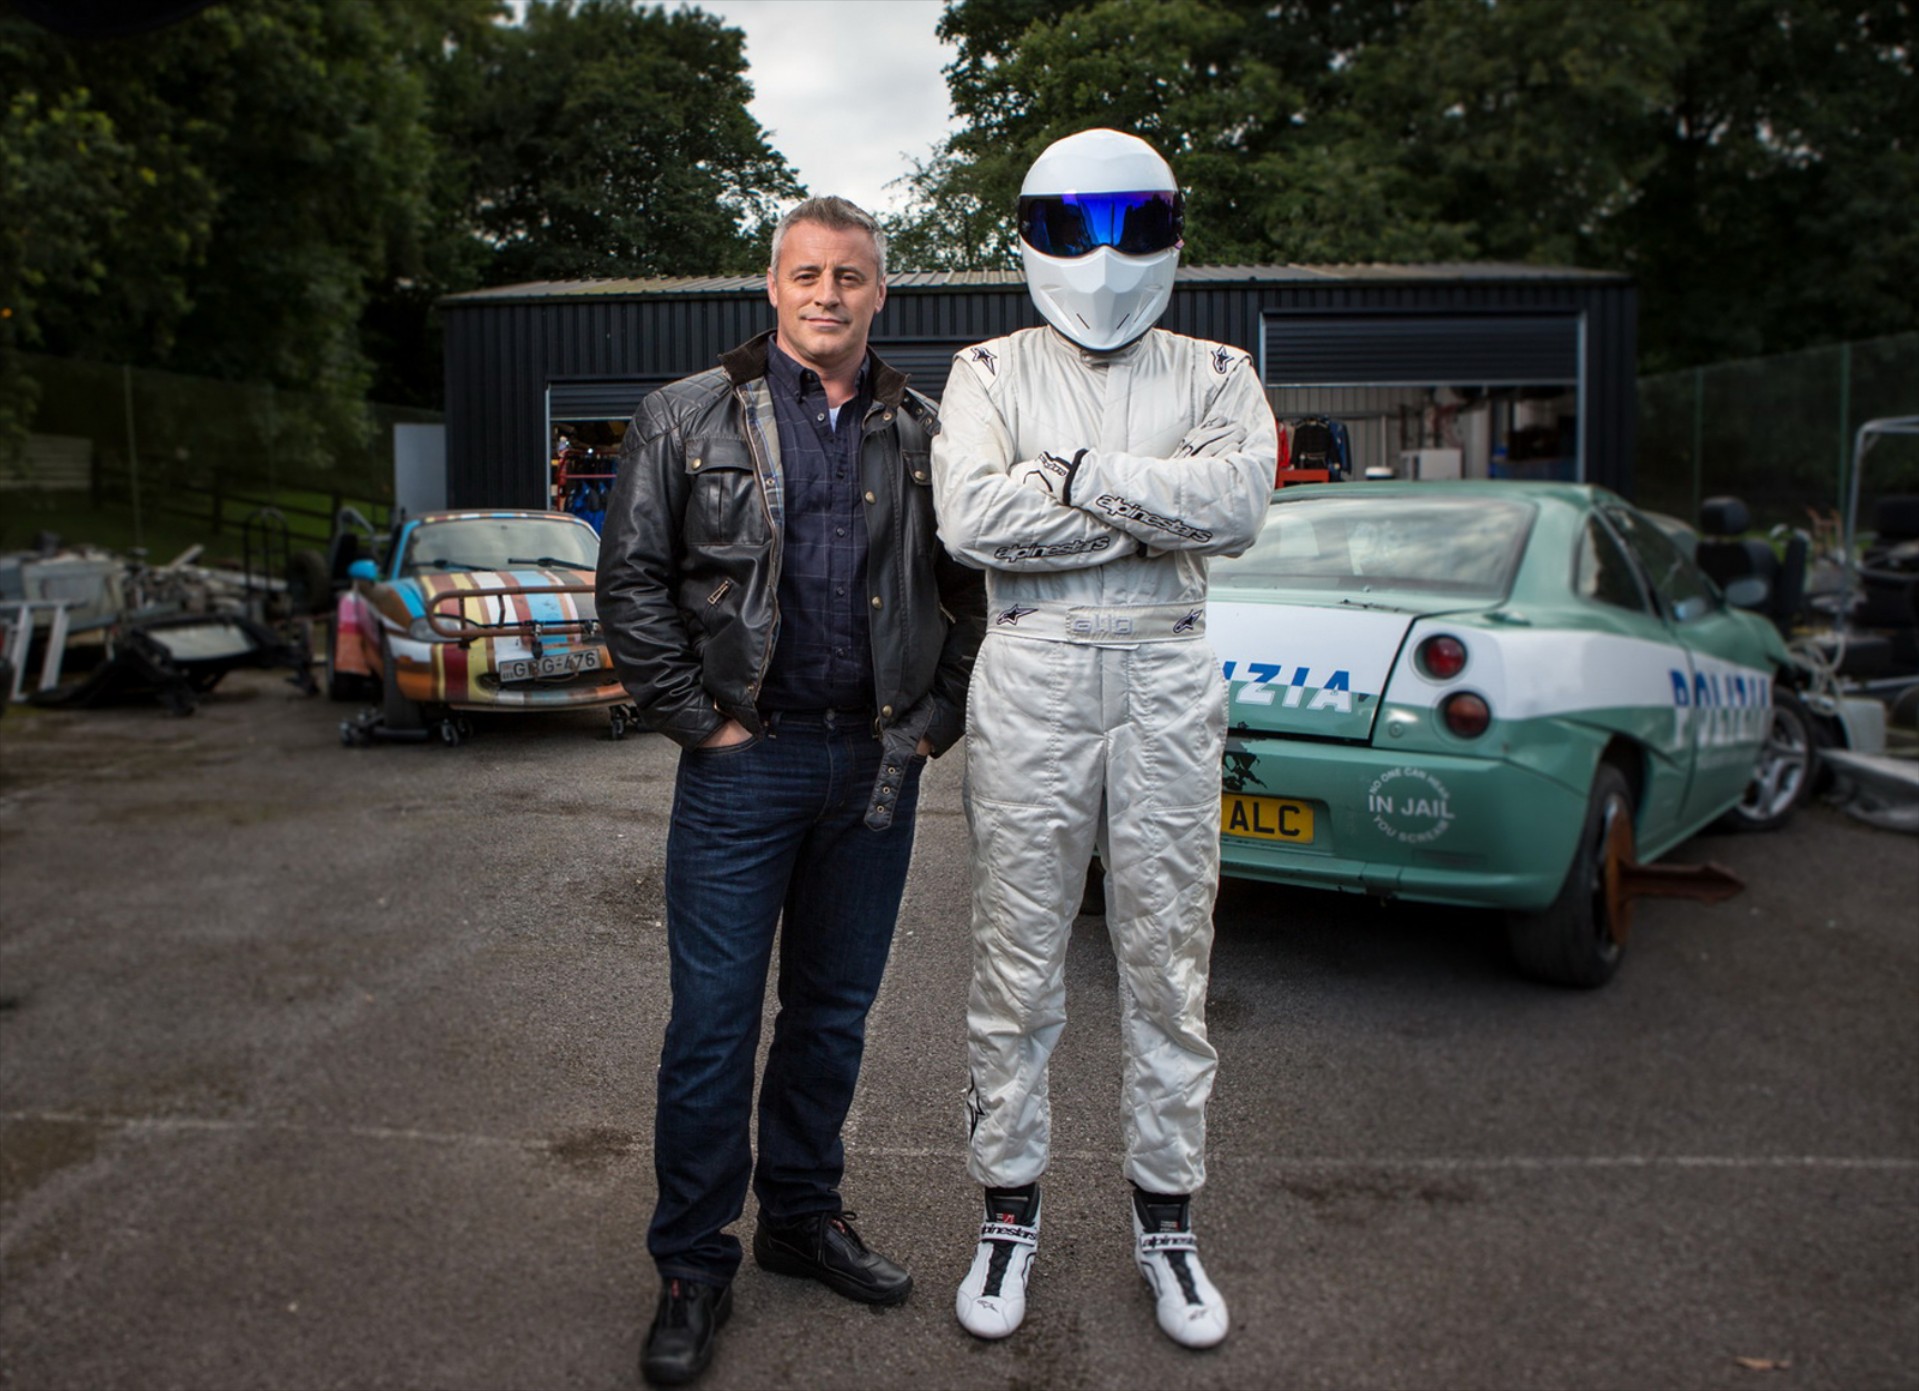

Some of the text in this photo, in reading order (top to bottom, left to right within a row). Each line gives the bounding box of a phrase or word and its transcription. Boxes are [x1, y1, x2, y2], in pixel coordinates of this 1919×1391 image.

[1096, 495, 1212, 543] alpinestars
[994, 536, 1110, 562] alpinestars
[1229, 800, 1301, 837] ALC
[1369, 795, 1455, 819] IN JAIL
[1374, 814, 1397, 837] YOU
